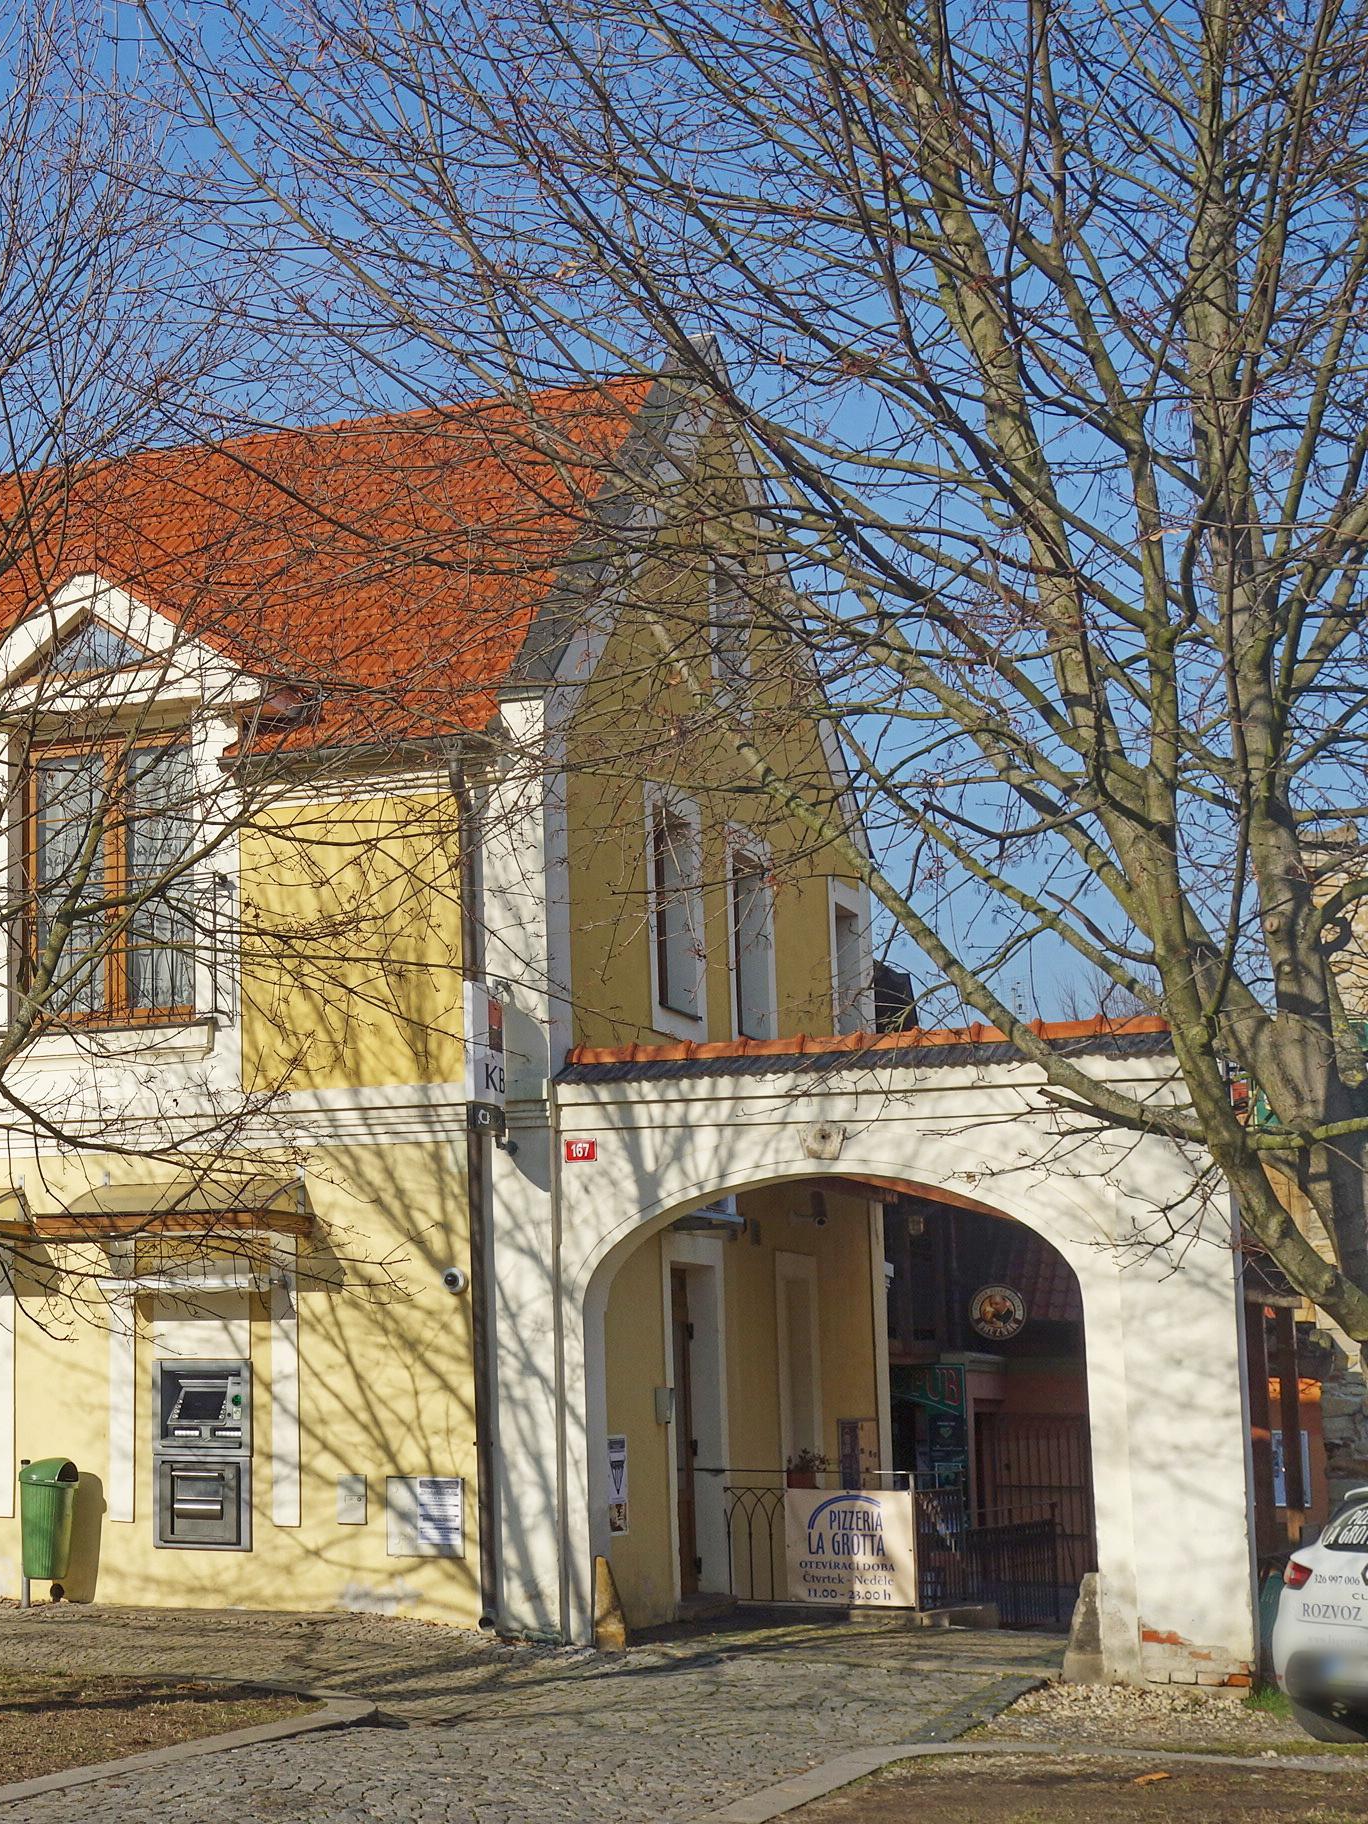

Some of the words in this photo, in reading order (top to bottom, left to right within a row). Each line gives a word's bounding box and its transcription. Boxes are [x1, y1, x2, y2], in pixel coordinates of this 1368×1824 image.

[484, 1062, 506, 1094] KB
[570, 1143, 590, 1158] 167
[829, 1510, 883, 1532] PIZZERIA
[808, 1531, 825, 1555] LA
[832, 1532, 886, 1556] GROTTA
[799, 1560, 860, 1572] OTEVÍRACÍ
[863, 1562, 895, 1572] DOBA
[803, 1570, 845, 1585] Čtvrtek
[854, 1574, 894, 1586] Neděle
[1328, 1574, 1343, 1584] 997
[1344, 1575, 1360, 1585] 006
[807, 1588, 837, 1599] 11.00
[848, 1589, 881, 1600] 23.00
[883, 1589, 891, 1600] h
[1302, 1602, 1363, 1621] ROZVOZ
